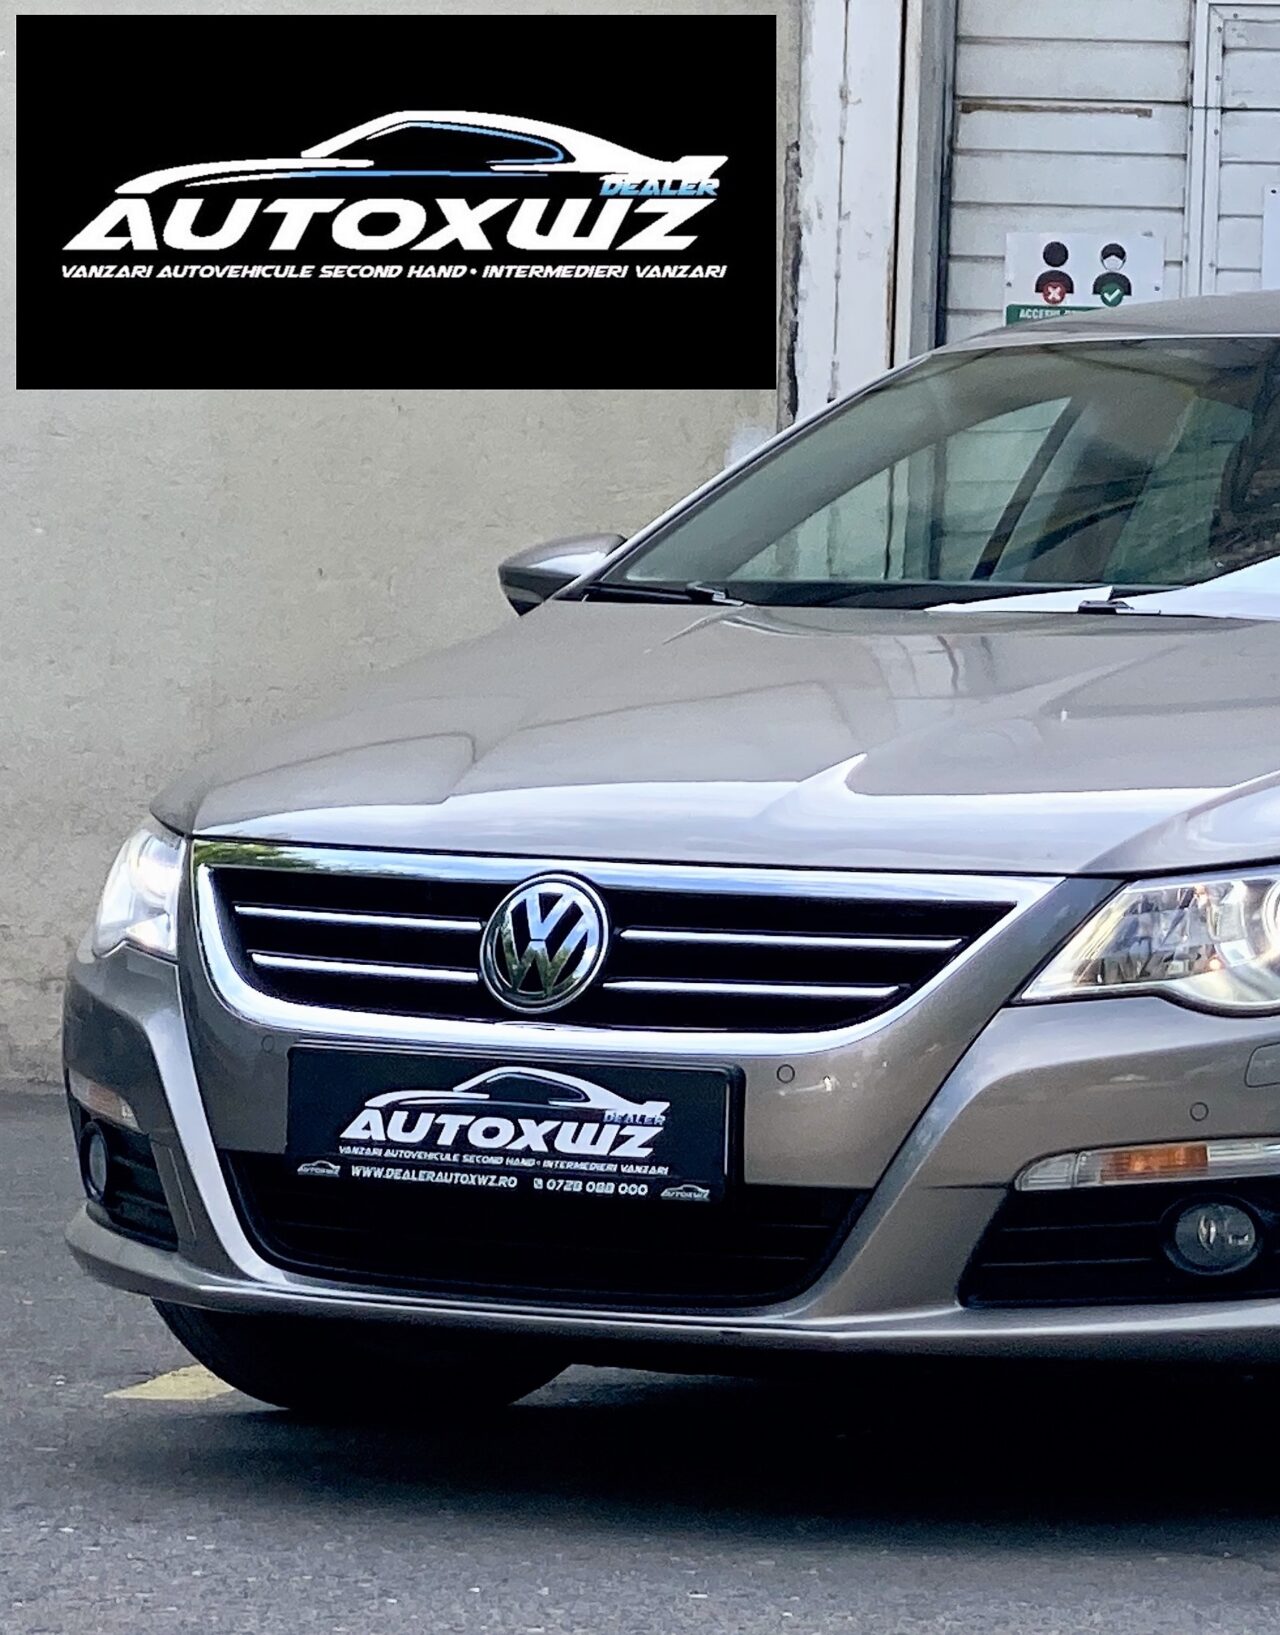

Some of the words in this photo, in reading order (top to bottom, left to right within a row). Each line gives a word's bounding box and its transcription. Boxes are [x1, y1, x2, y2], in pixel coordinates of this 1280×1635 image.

[603, 1110, 666, 1126] DEALER
[340, 1108, 665, 1158] AUTOXWZ
[338, 1145, 383, 1157] VANZARI
[383, 1148, 461, 1163] AUTOVEHICULE
[461, 1154, 504, 1165] SECOND
[542, 1158, 619, 1173] INTERMEDIERI
[620, 1164, 670, 1176] VANZARI
[351, 1165, 518, 1188] WWW.DEALERAUTOXWZ.RO
[618, 1183, 649, 1196] 000
